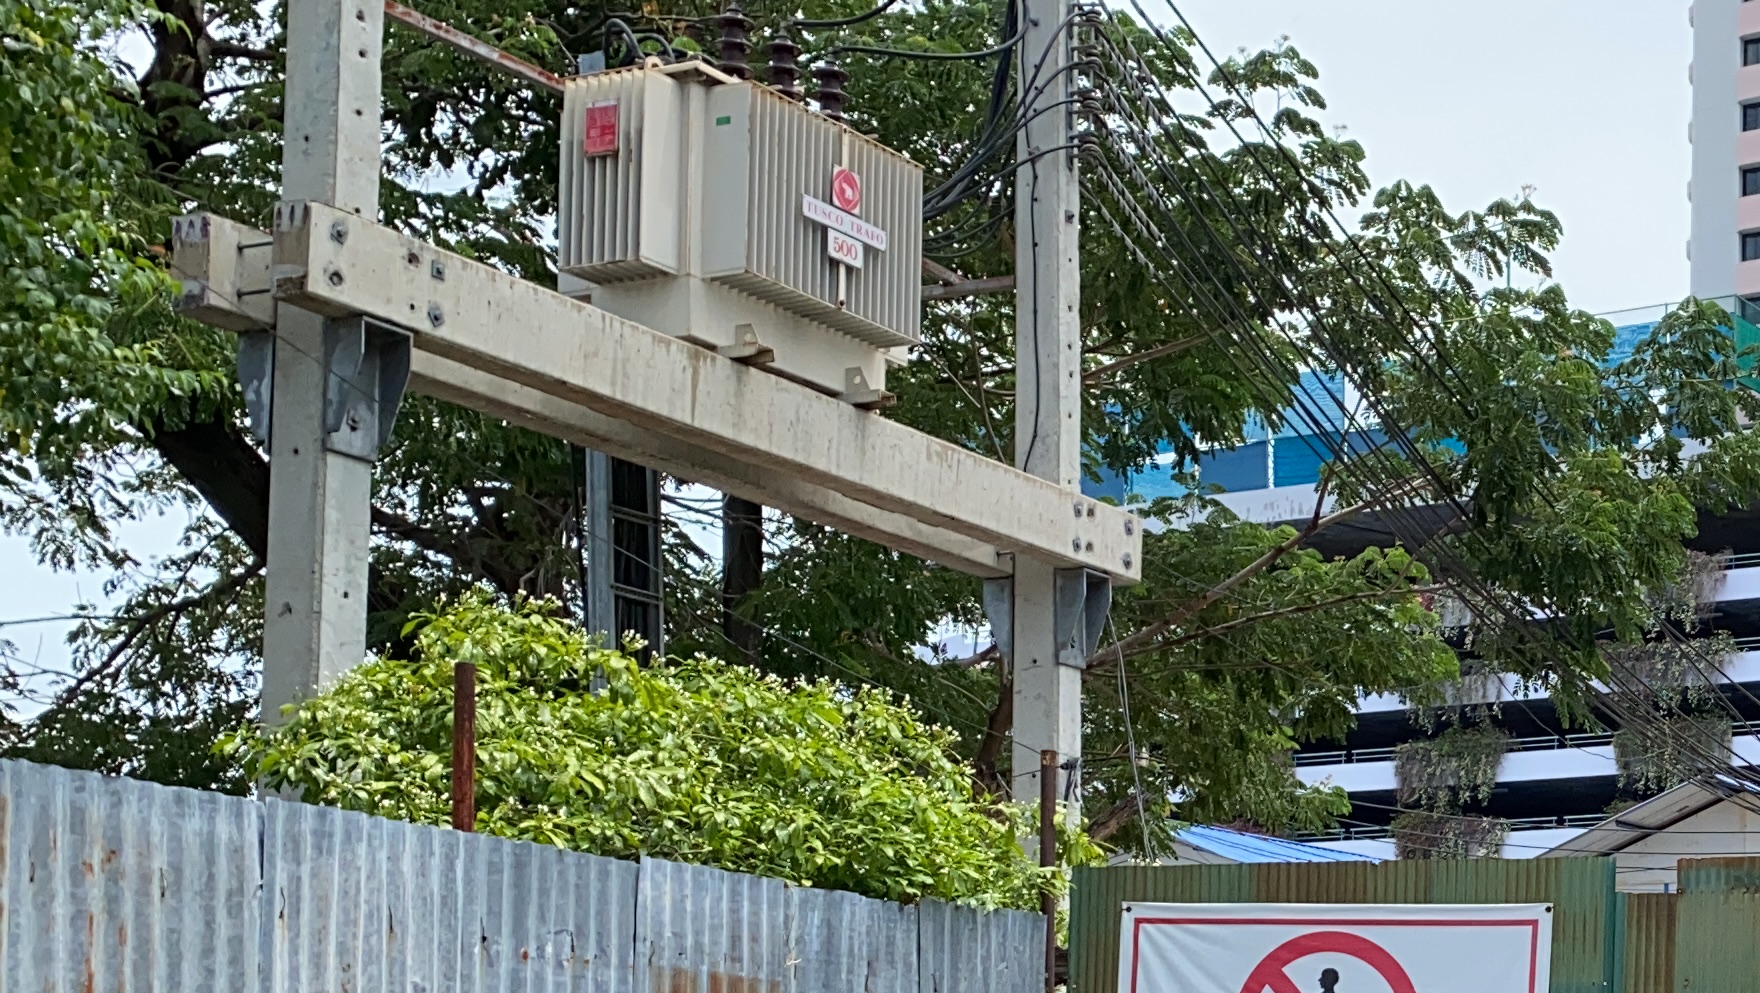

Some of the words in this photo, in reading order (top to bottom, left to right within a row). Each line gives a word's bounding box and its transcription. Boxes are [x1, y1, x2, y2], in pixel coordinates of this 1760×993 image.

[806, 200, 843, 227] TUSCO
[849, 220, 884, 246] TRAFO
[833, 236, 858, 261] 500
